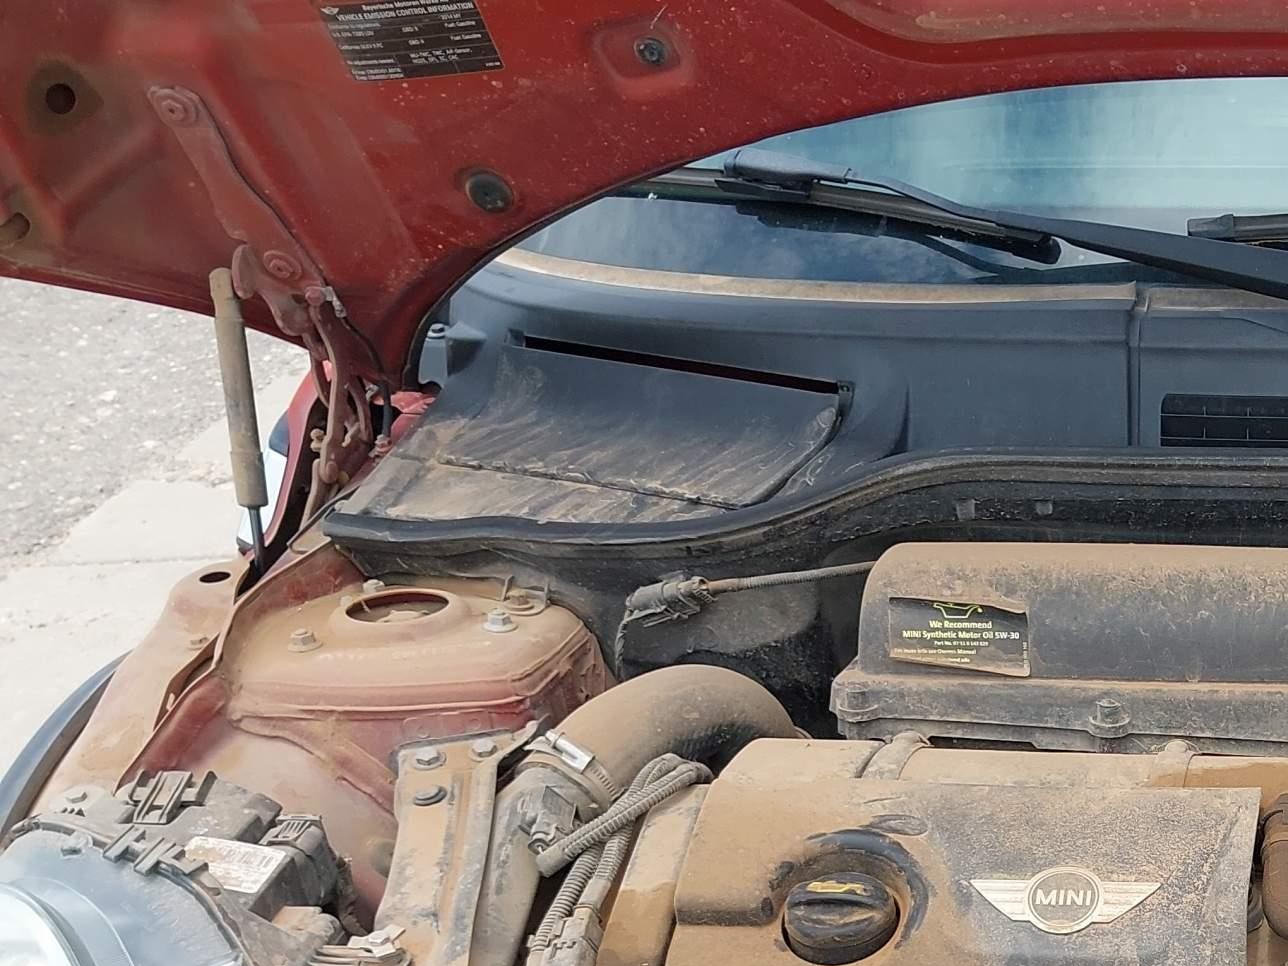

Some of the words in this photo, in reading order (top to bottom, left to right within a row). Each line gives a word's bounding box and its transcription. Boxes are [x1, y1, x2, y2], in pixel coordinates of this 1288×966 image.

[336, 13, 364, 22] VEHICLE
[364, 9, 396, 20] EMISSION
[396, 6, 428, 17] CONTROL
[428, 2, 475, 14] INFORMATION
[929, 620, 943, 629] We
[943, 620, 992, 629] Recommend
[902, 630, 921, 638] MINI
[922, 630, 957, 640] Synthetic
[958, 630, 981, 639] Motor
[982, 631, 994, 639] Oil
[994, 631, 1020, 640] 5W-30
[1035, 888, 1092, 906] MINI
